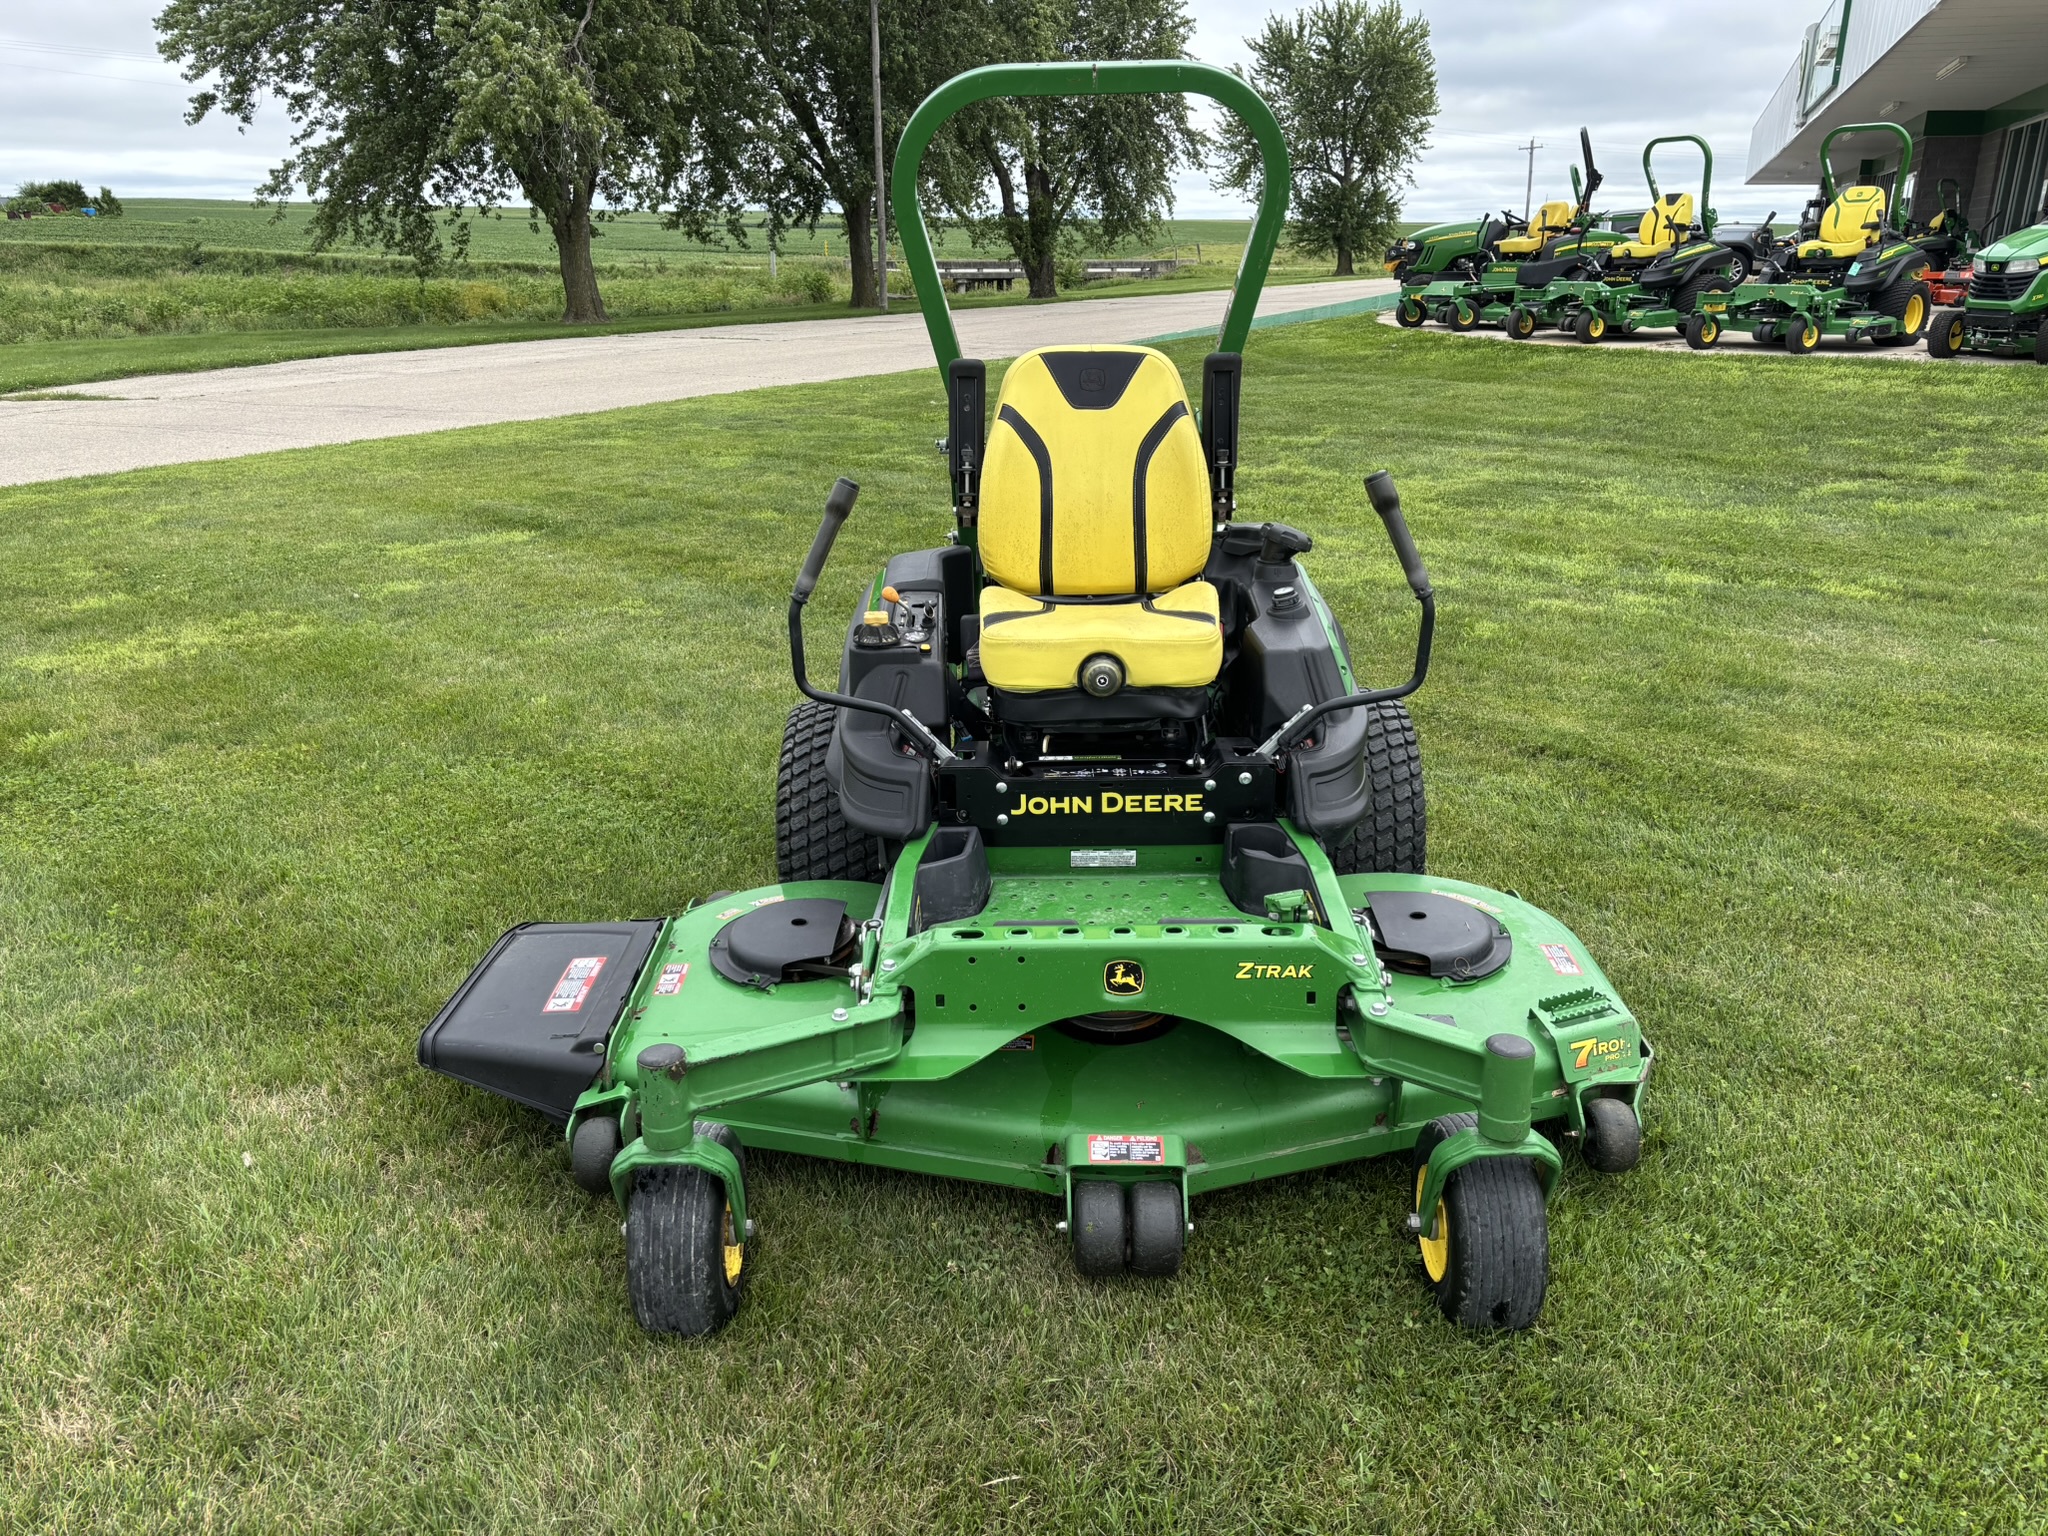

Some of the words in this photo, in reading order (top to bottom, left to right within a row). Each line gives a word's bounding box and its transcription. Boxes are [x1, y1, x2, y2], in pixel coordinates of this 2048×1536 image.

[1010, 793, 1093, 815] JOHN
[1101, 791, 1204, 813] DEERE
[1235, 962, 1315, 979] ZTRAK
[1604, 1052, 1620, 1062] PRO
